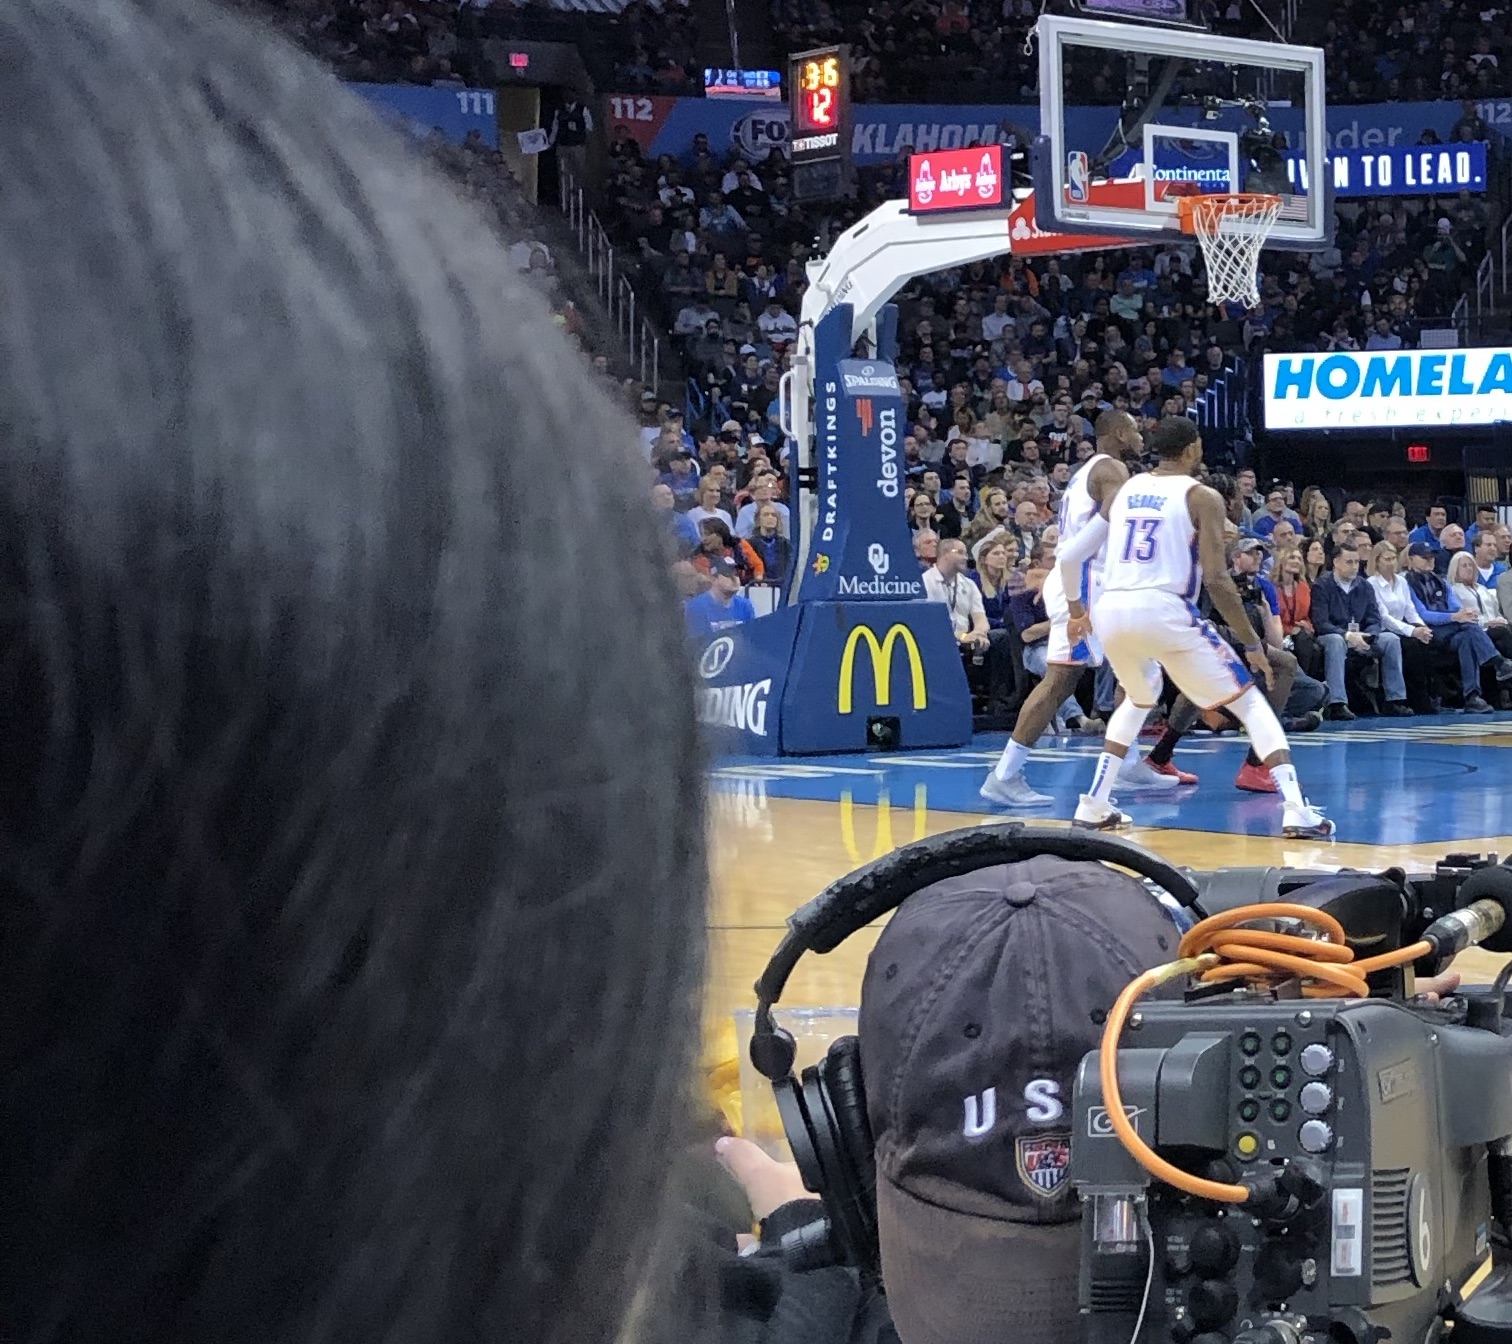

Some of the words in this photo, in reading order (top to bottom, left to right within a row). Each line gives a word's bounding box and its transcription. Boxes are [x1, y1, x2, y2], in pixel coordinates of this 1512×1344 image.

[456, 91, 494, 115] 111
[610, 96, 654, 122] 112
[805, 133, 839, 150] TISSOT
[1361, 154, 1393, 188] TO
[1405, 151, 1482, 186] LEAD.
[843, 372, 899, 390] SPALDING
[821, 381, 837, 542] DRAFTKINGS
[876, 407, 897, 499] devon
[1119, 516, 1165, 565] 13
[837, 576, 922, 596] Medicine
[1415, 1189, 1432, 1269] 6
